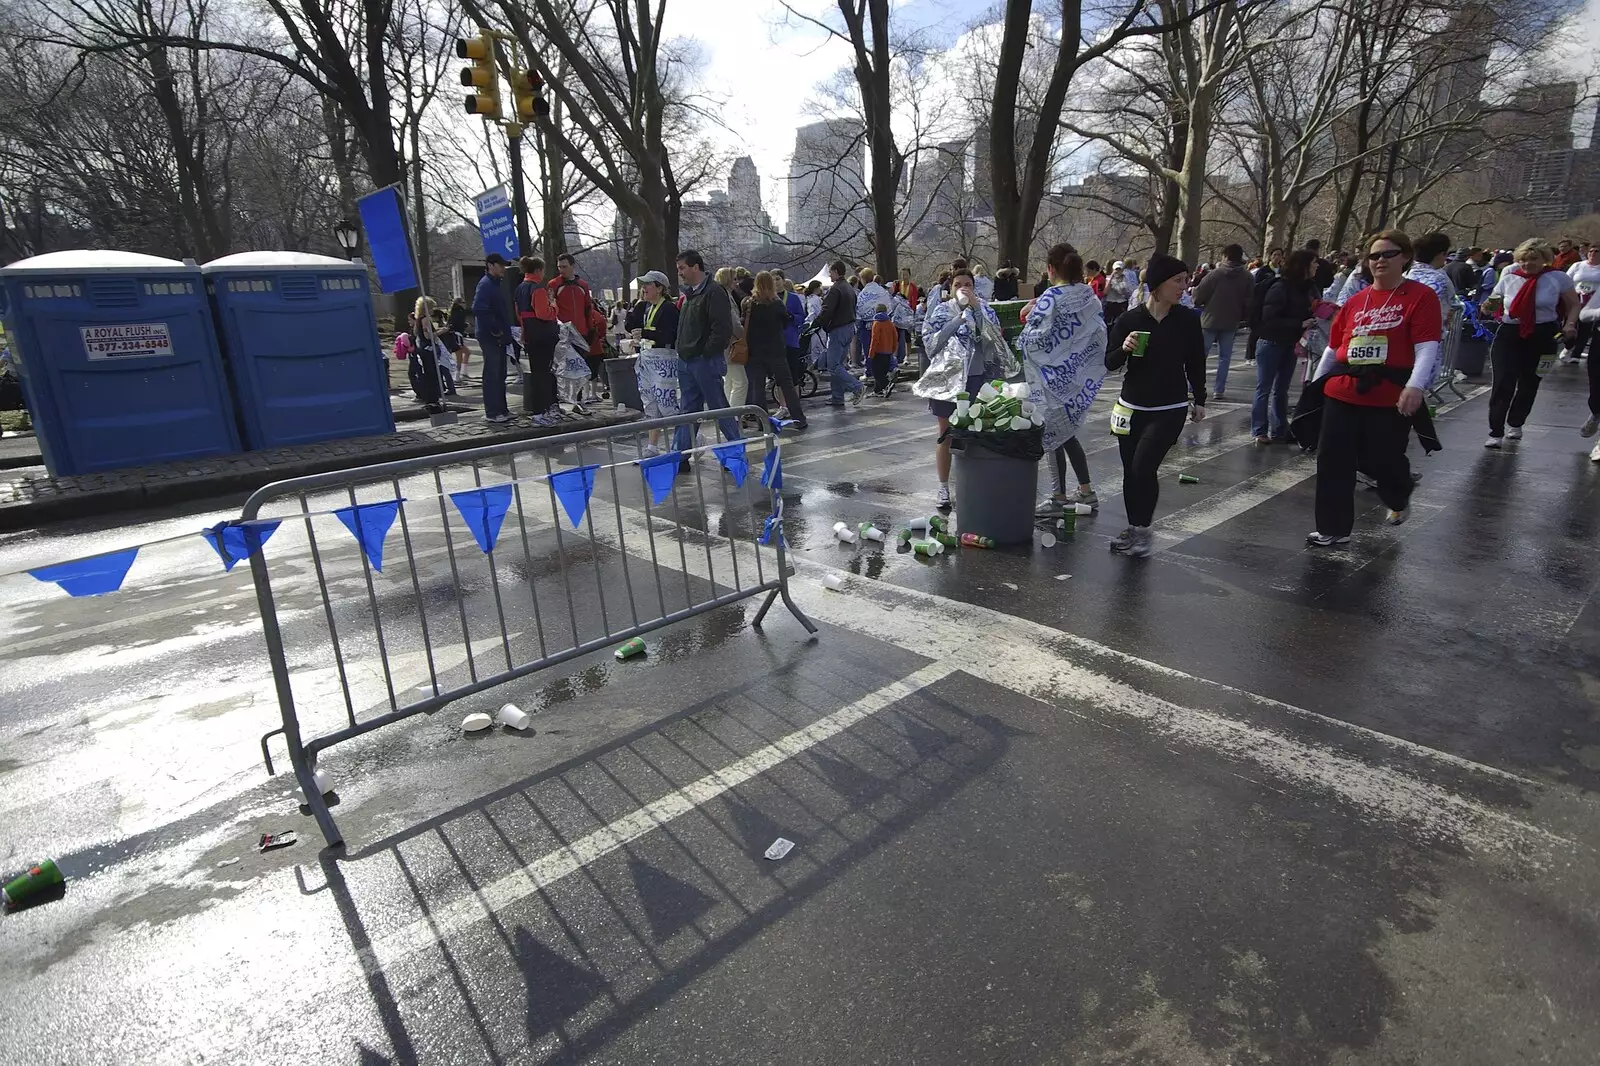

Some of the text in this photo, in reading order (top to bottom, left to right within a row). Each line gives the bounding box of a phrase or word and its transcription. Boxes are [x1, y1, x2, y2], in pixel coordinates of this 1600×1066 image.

[1370, 311, 1398, 325] Dolls
[85, 329, 92, 338] A
[94, 328, 123, 338] ROYAL
[125, 326, 151, 336] FLUSH
[87, 340, 169, 352] 1-877-234-6545
[1351, 346, 1381, 358] 6561
